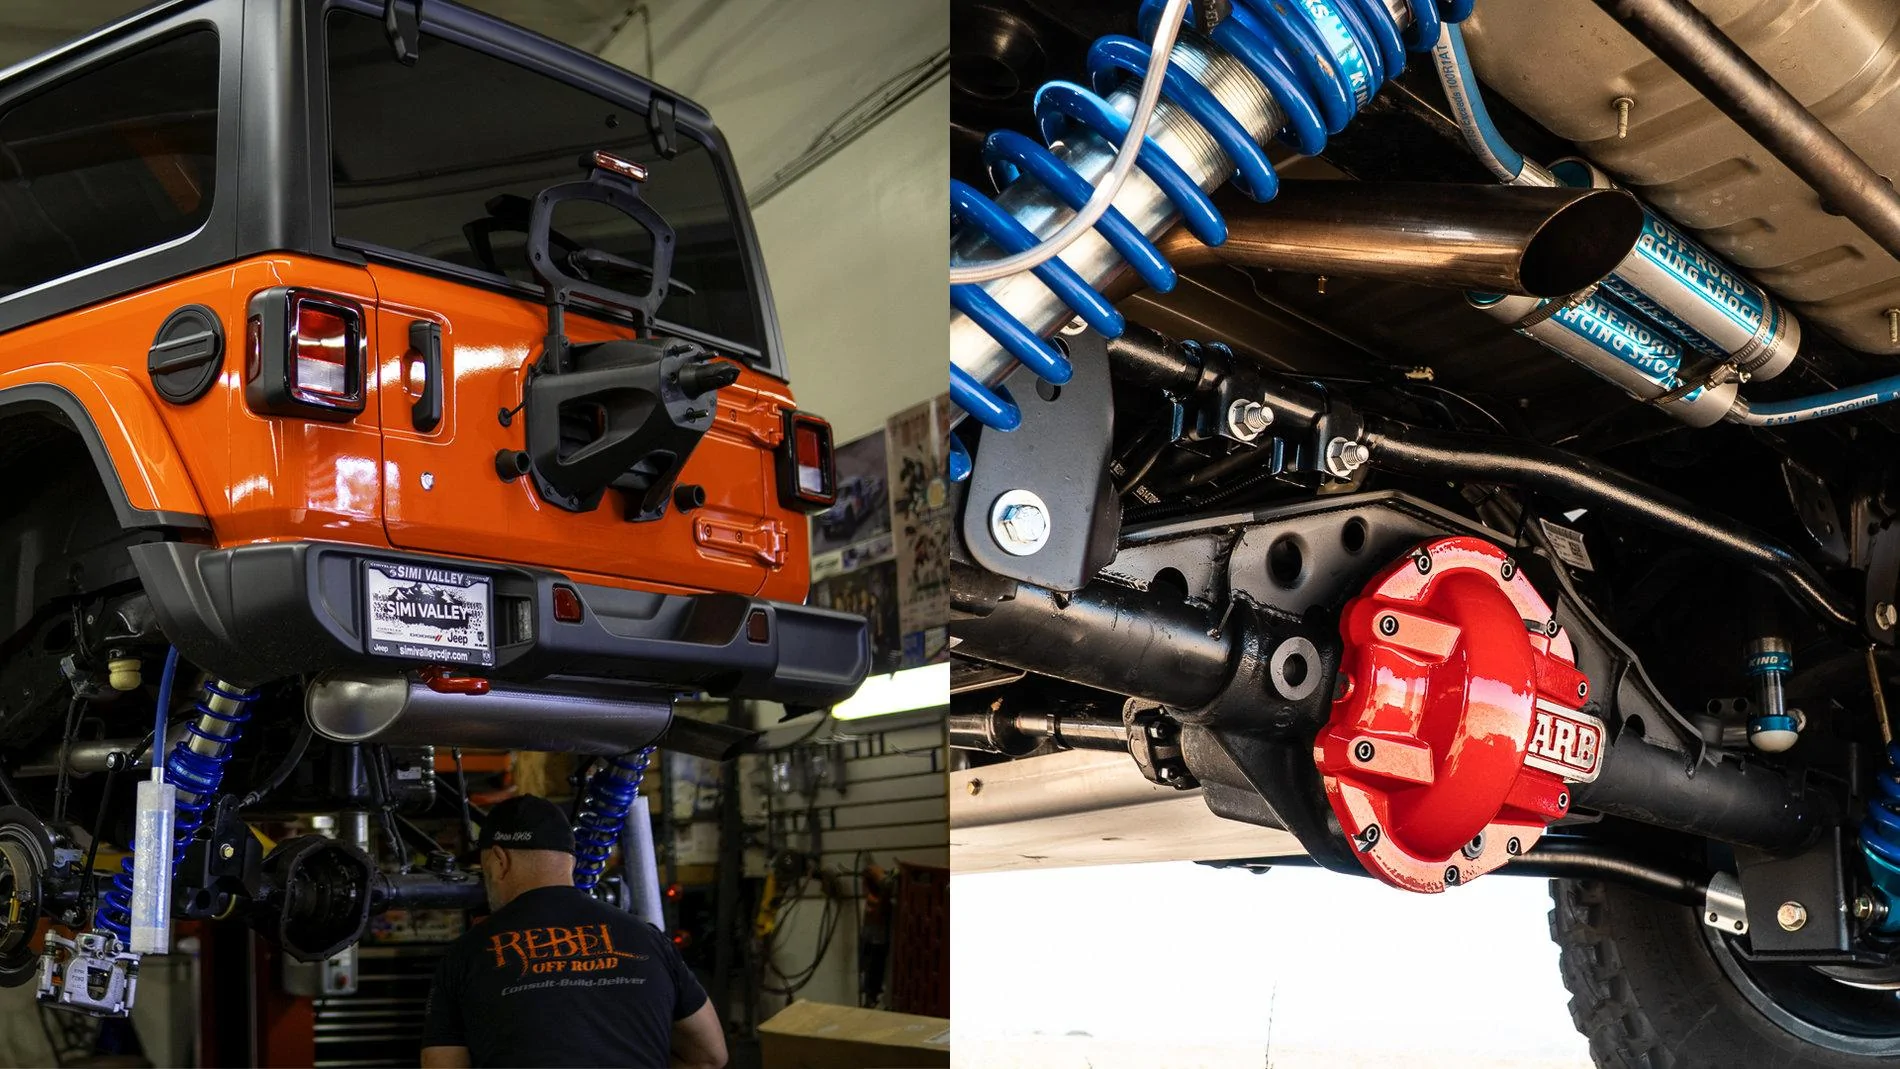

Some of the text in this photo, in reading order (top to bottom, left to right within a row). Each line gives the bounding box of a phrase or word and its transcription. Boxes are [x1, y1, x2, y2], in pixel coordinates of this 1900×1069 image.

[1653, 221, 1745, 296] OFF-ROAD
[1640, 233, 1762, 325] ACING SHOCK
[397, 565, 421, 580] SIMI
[425, 567, 464, 585] VALLEY
[386, 600, 468, 621] SIMI VALLEY
[447, 631, 468, 645] Jeep
[373, 644, 389, 653] Jeep
[400, 645, 469, 662] simivalleycdjr.com
[1748, 656, 1779, 667] KING
[1527, 712, 1596, 769] ARB
[487, 923, 628, 973] REBEL
[532, 957, 619, 974] OFF ROAD
